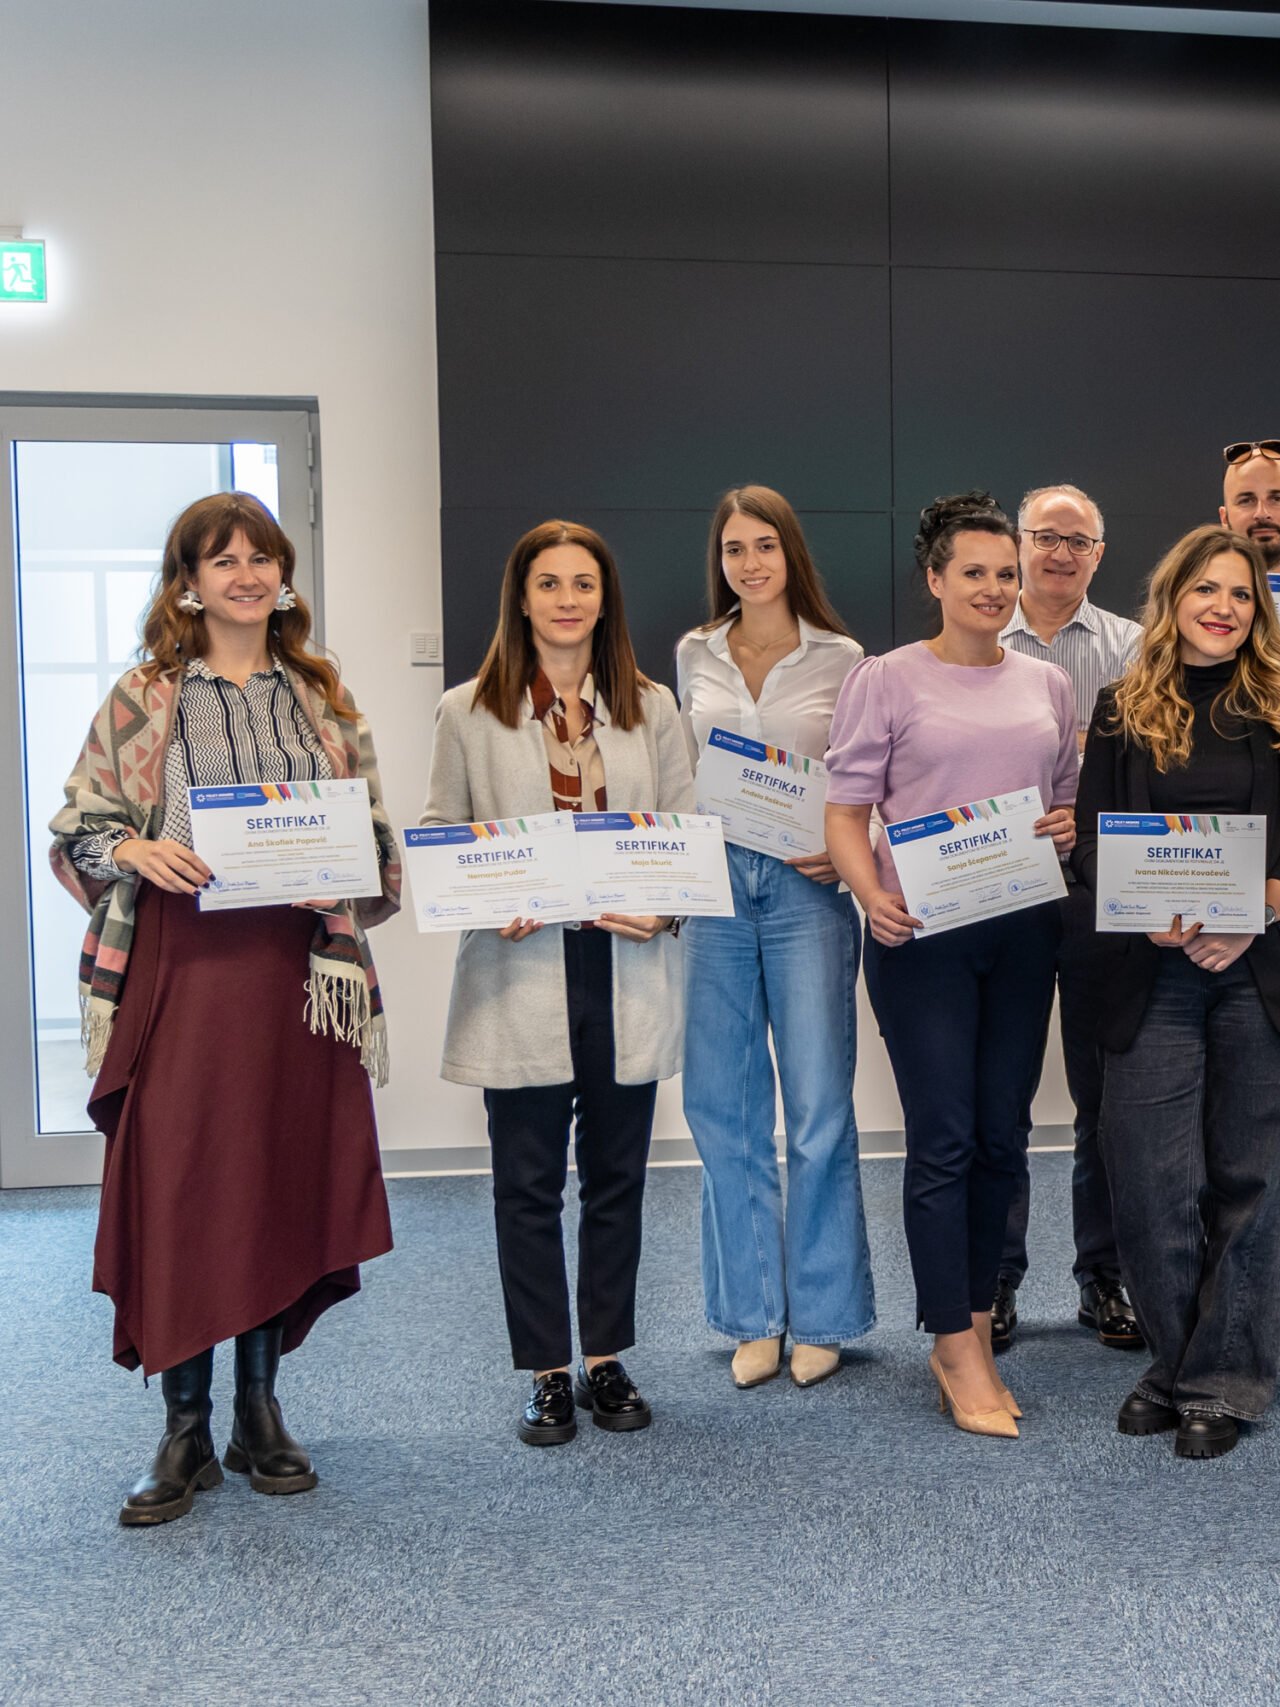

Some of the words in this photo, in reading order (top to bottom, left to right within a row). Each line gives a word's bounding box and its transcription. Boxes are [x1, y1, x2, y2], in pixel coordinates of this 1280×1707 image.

[741, 767, 806, 797] SERTIFIKAT
[246, 814, 327, 830] SERTIFIKAT
[615, 840, 686, 852] SERTIFIKAT
[938, 827, 1008, 856] SERTIFIKAT
[457, 847, 534, 865] SERTIFIKAT
[1147, 847, 1223, 859] SERTIFIKAT
[946, 862, 967, 872] Sanja
[1191, 869, 1230, 877] Kovačević
